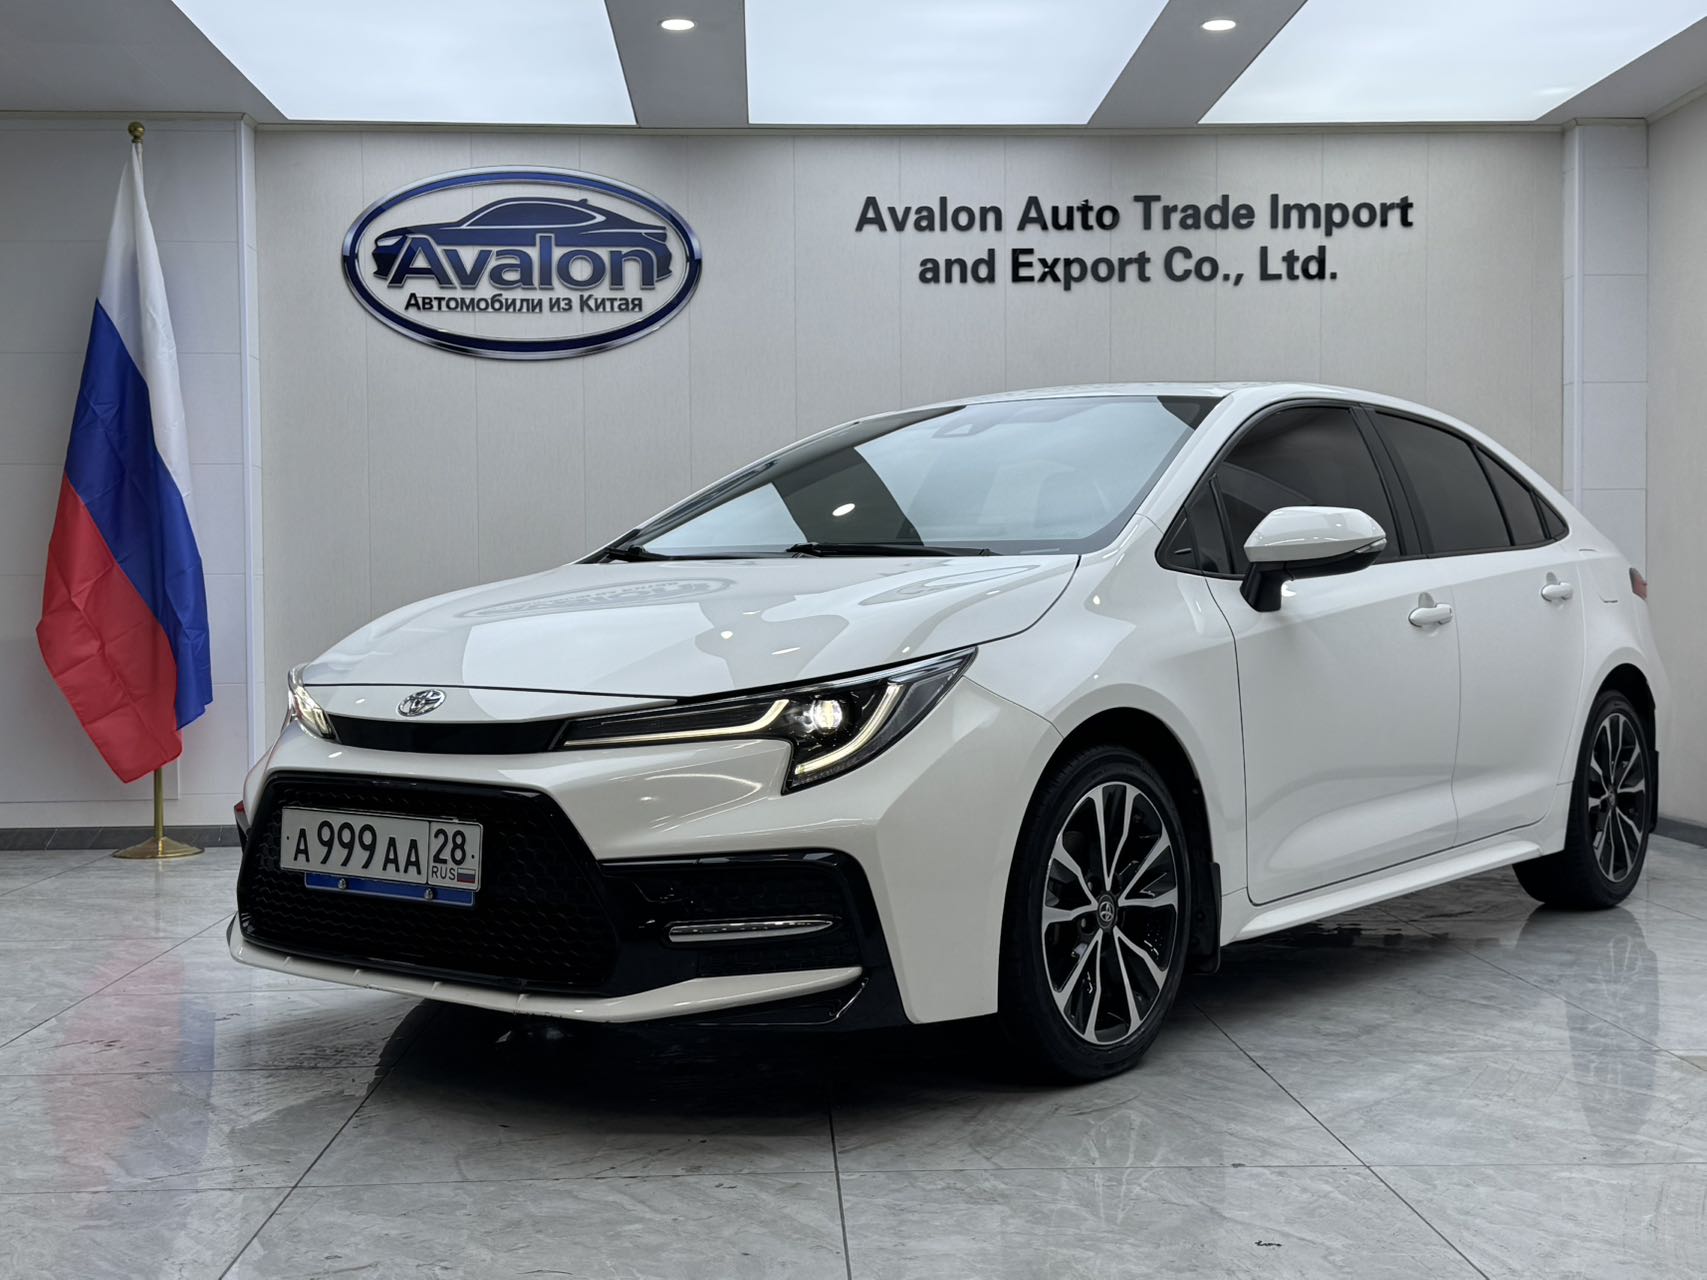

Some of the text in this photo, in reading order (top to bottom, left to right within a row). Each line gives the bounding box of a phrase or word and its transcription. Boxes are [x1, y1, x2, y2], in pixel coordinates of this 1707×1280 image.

[855, 193, 1414, 236] Avalon Auto Trade Import
[386, 233, 656, 291] Avalon
[918, 245, 1339, 290] and Export Co., Ltd.
[404, 293, 643, 313] Автомобили из Китая
[432, 828, 467, 866] 28
[431, 865, 456, 881] RUS
